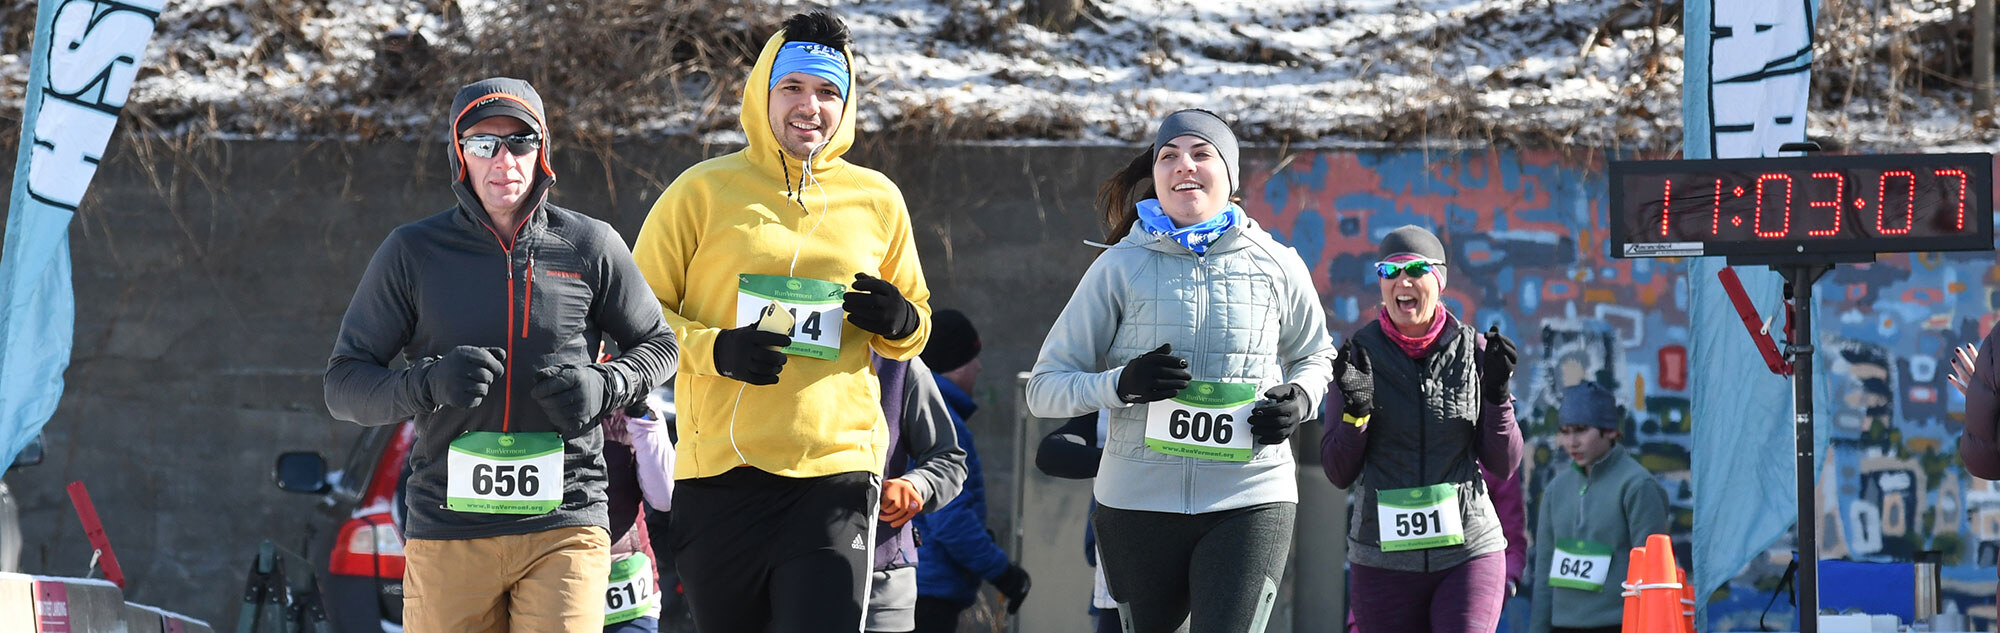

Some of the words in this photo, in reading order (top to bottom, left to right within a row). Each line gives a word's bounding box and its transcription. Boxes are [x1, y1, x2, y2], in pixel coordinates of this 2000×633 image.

[760, 305, 822, 341] 14
[1186, 394, 1225, 403] RunVermont
[1169, 409, 1234, 444] 606
[486, 447, 527, 455] RunVermont
[1162, 445, 1234, 459] www.RunVermont.org
[472, 463, 540, 497] 656
[466, 502, 543, 512] www.RunVermont.org
[1395, 509, 1442, 537] 591
[1560, 557, 1593, 579] 642
[605, 577, 648, 610] 612
